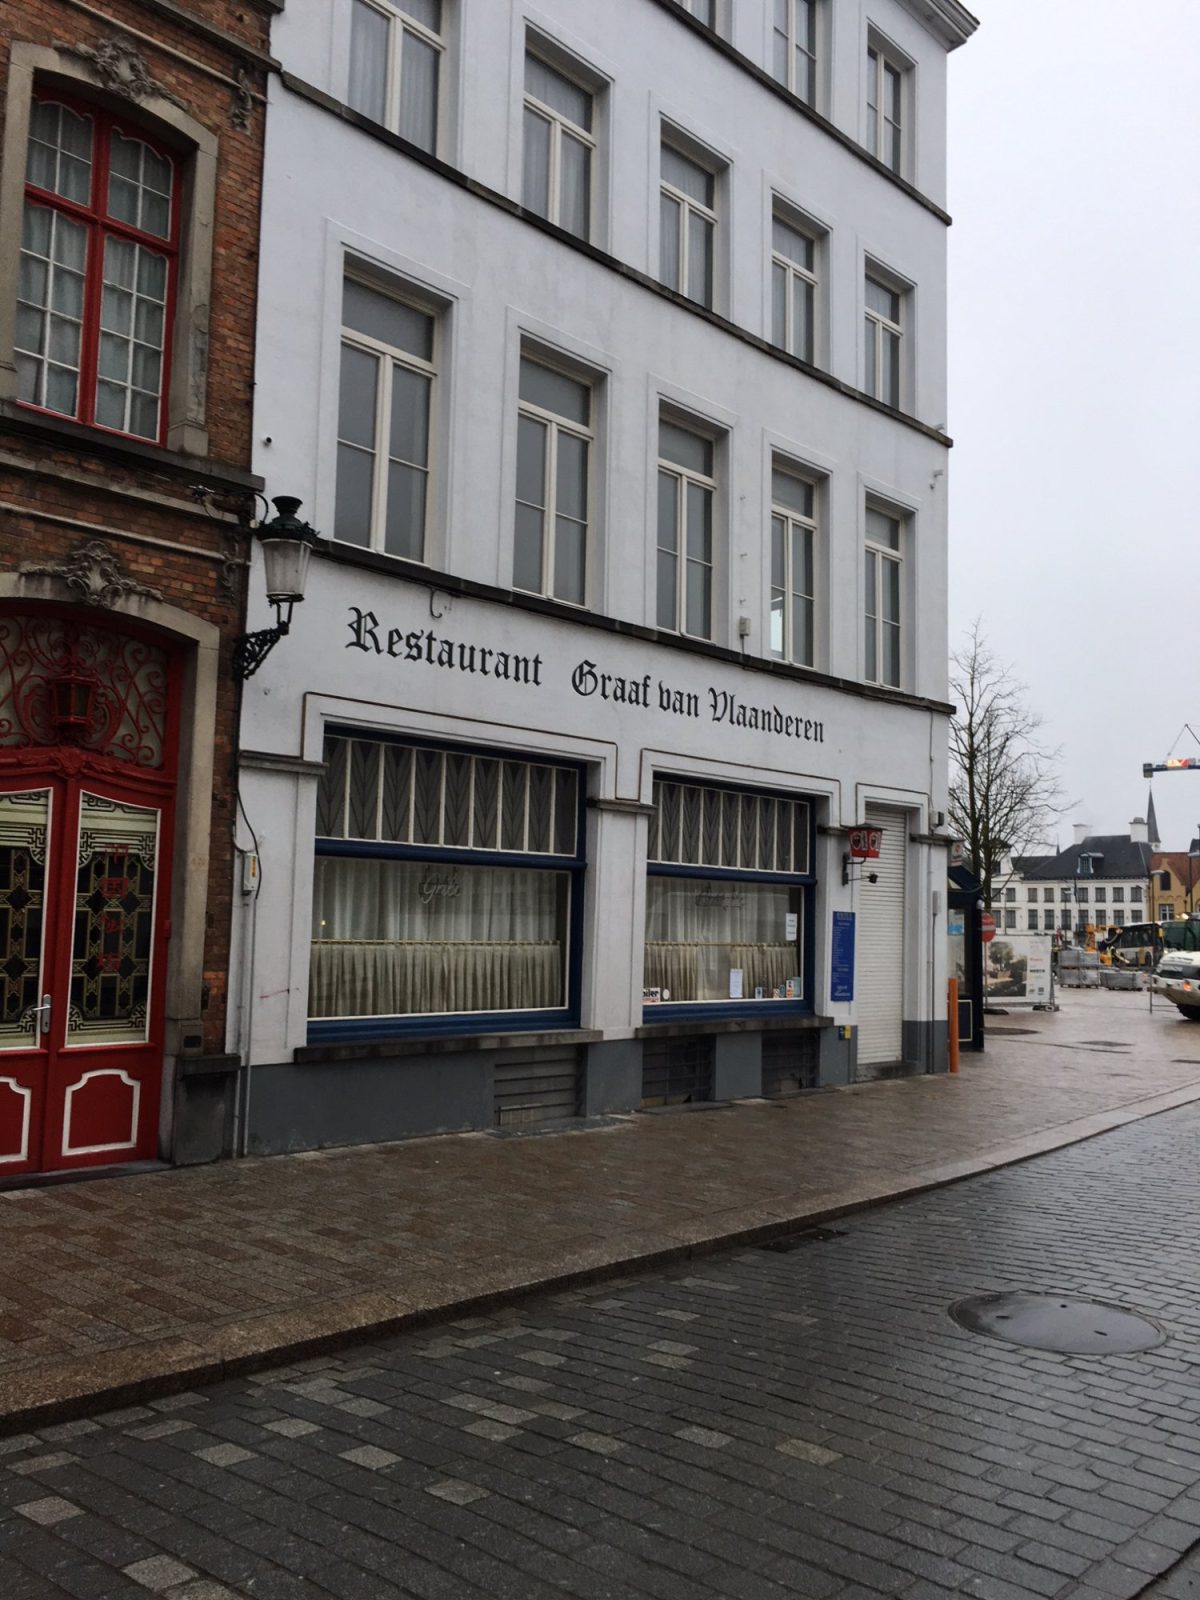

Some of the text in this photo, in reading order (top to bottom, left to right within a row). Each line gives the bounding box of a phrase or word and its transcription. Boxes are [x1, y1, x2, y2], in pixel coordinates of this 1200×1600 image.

[345, 606, 825, 744] Restaurant Graaf van Vlaanderen
